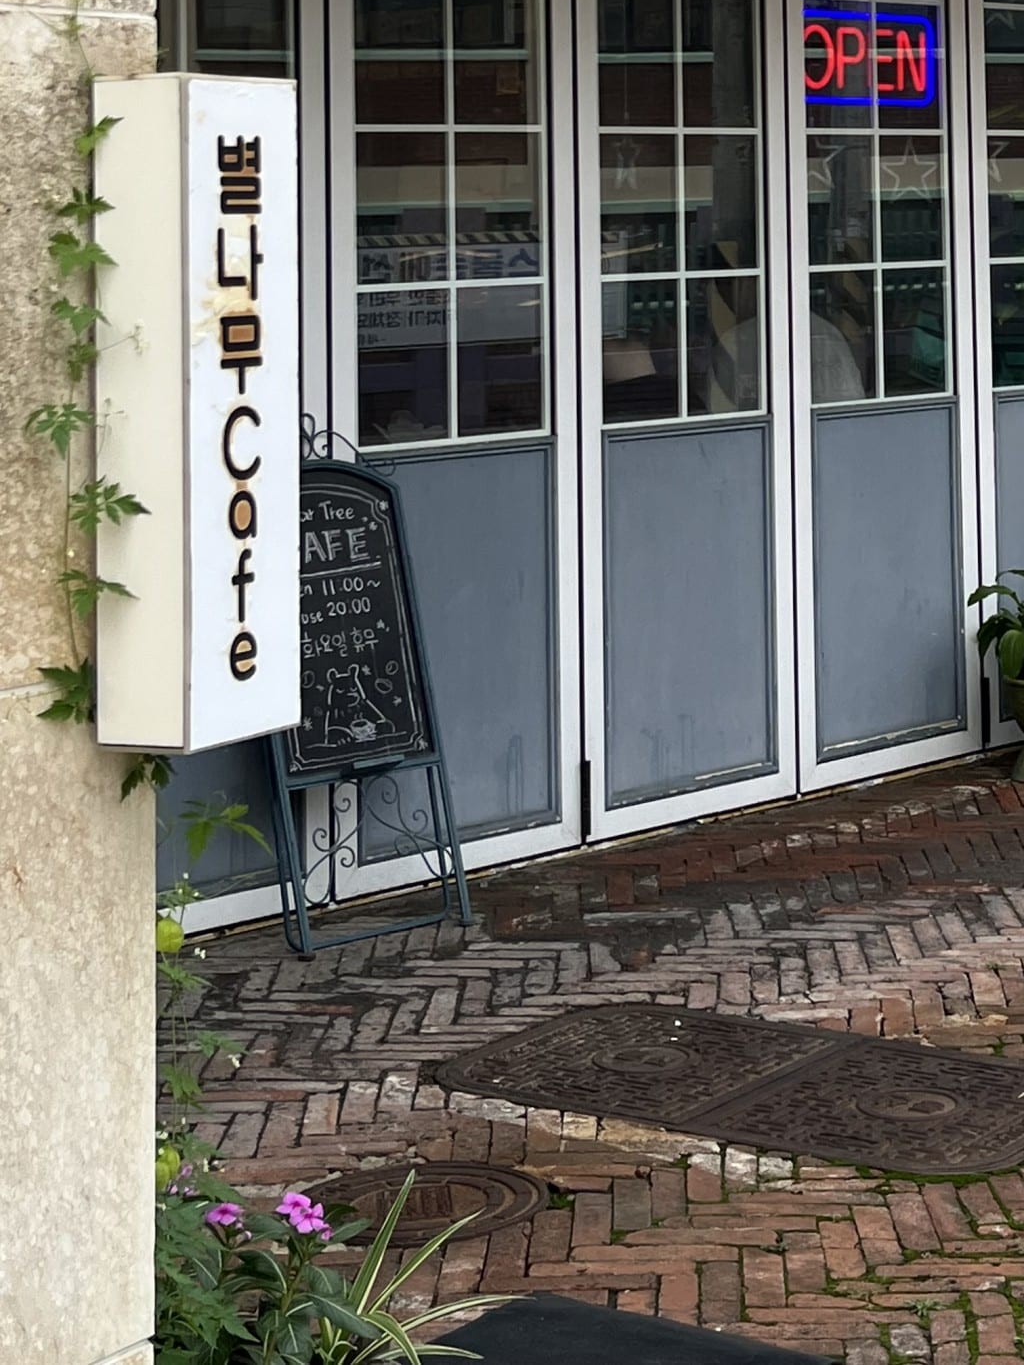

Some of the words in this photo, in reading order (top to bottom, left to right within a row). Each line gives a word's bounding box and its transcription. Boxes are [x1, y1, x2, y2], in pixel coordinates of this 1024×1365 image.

[803, 23, 927, 92] OPEN
[216, 134, 264, 395] 별나무
[318, 500, 355, 520] Tree
[220, 404, 263, 683] Cafe
[304, 527, 371, 564] AFE
[300, 611, 324, 625] ose
[300, 631, 349, 658] 화요일
[349, 627, 379, 653] 휴무
